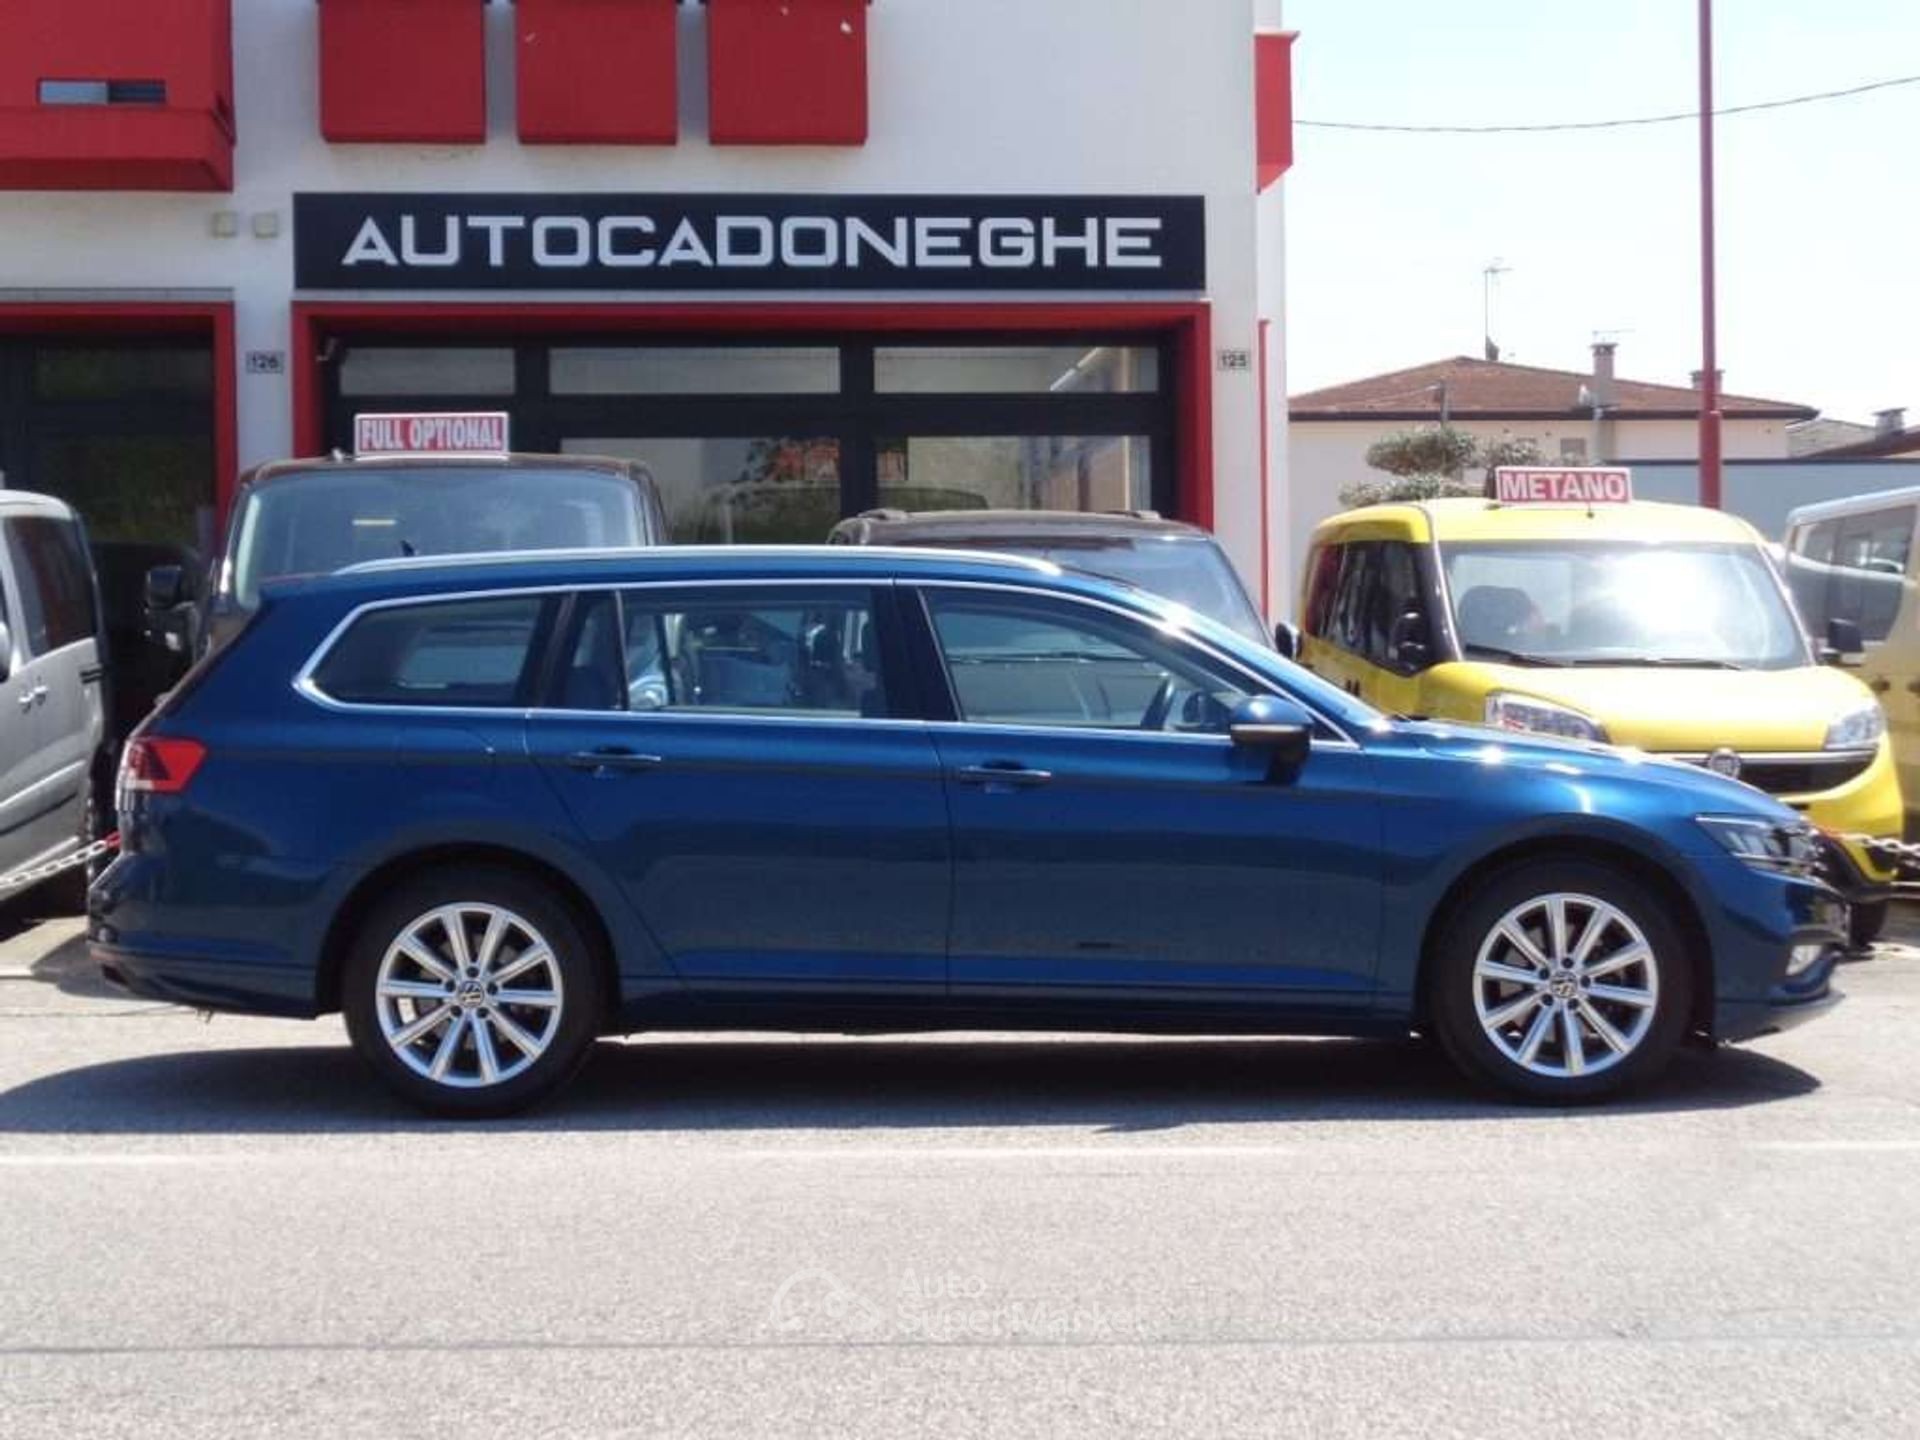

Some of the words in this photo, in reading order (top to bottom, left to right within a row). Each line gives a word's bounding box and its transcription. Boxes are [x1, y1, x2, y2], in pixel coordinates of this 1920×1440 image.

[342, 216, 1162, 267] AUTOCADONEGHE
[1221, 353, 1247, 368] 125
[361, 418, 403, 450] FULL
[409, 417, 501, 449] OPTIONAL
[1501, 471, 1625, 500] METANO
